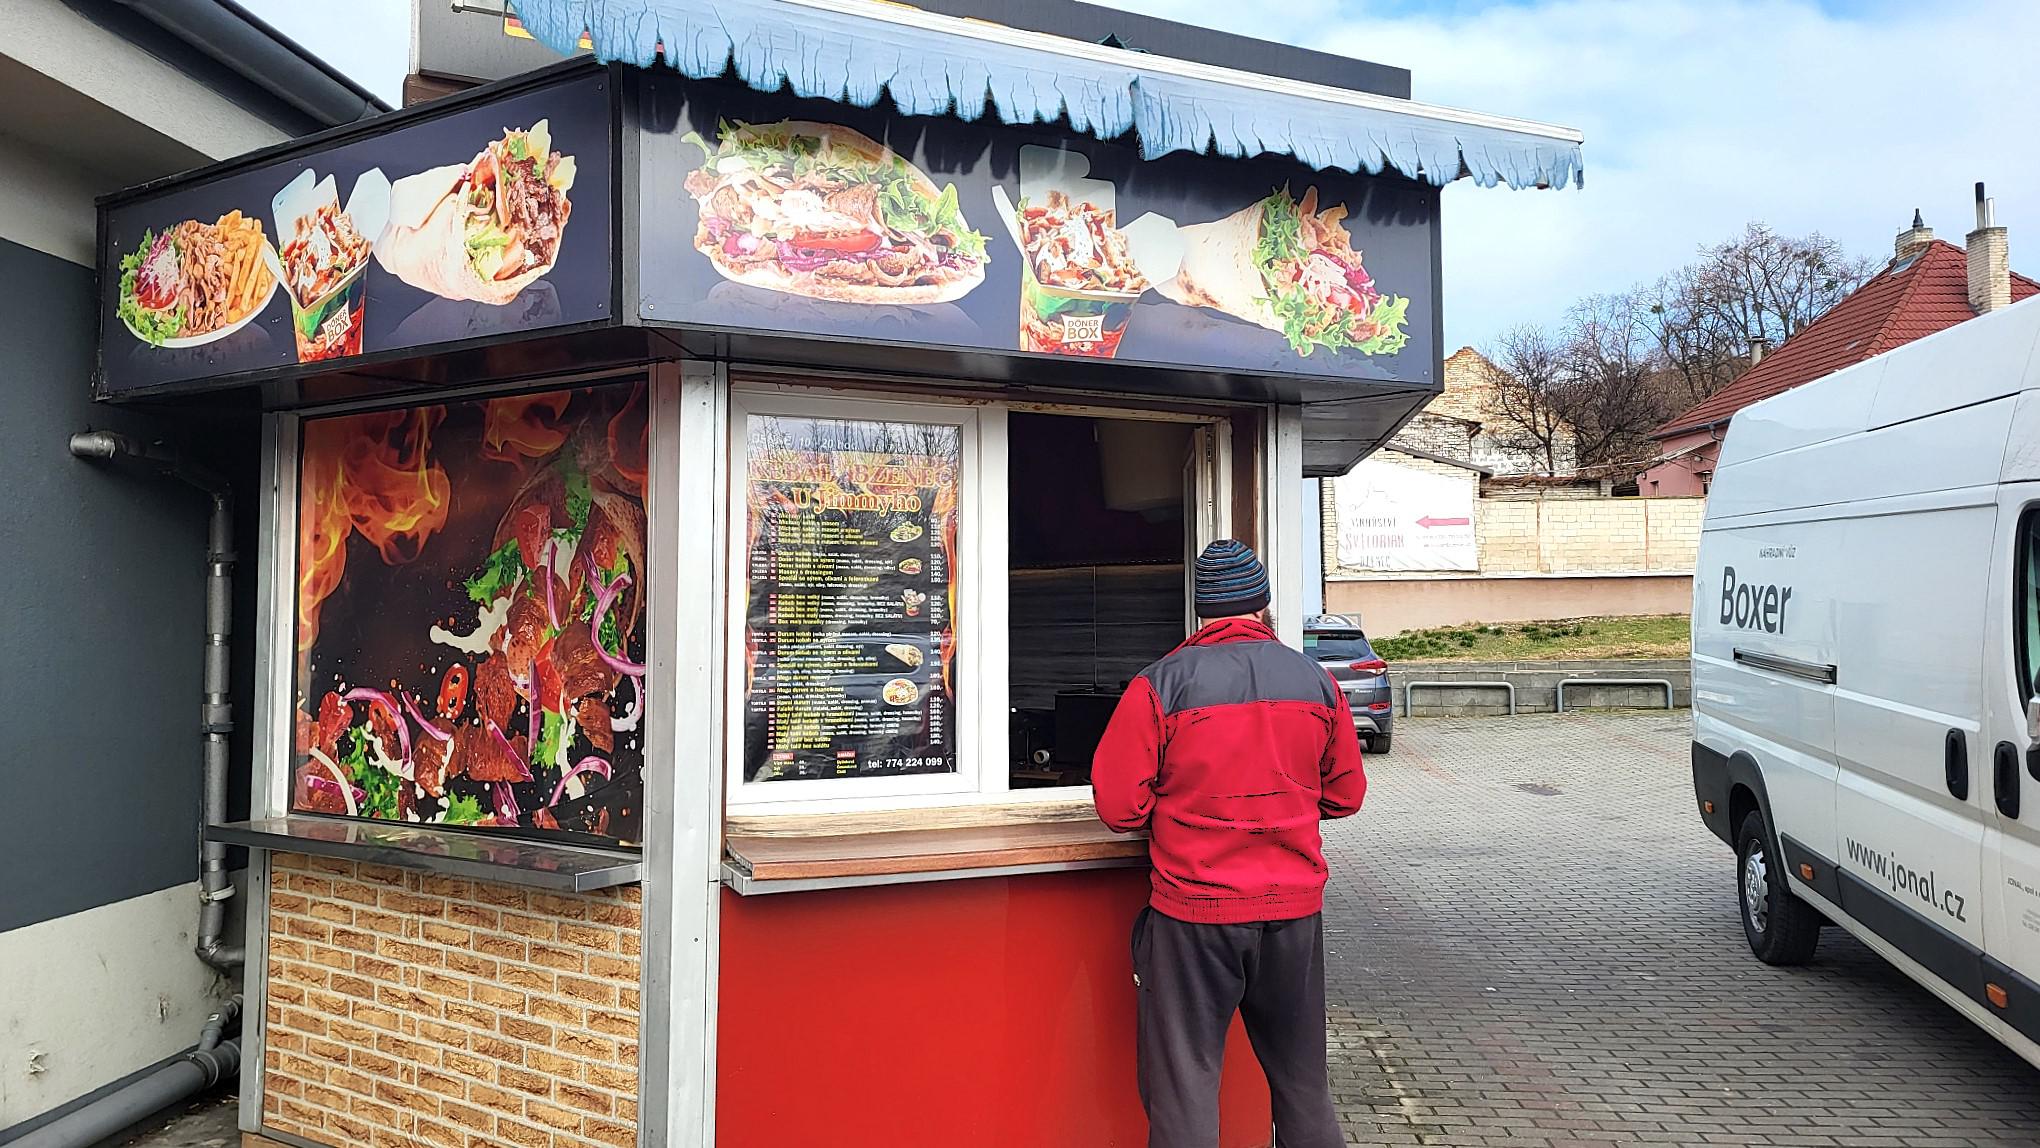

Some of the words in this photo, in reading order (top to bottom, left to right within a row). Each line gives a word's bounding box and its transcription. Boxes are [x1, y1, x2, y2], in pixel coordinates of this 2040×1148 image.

[327, 309, 347, 331] DÖNER
[328, 320, 349, 342] BOX
[1068, 319, 1099, 327] DÖNER
[1068, 327, 1099, 339] BOX
[791, 487, 812, 509] U
[813, 488, 922, 517] Jimmyho
[1720, 566, 1793, 634] Boxer
[868, 760, 882, 768] tel:
[886, 759, 903, 768] 774
[906, 758, 922, 767] 224
[926, 757, 942, 766] 099
[1846, 836, 1966, 923] www.jonal.cz
